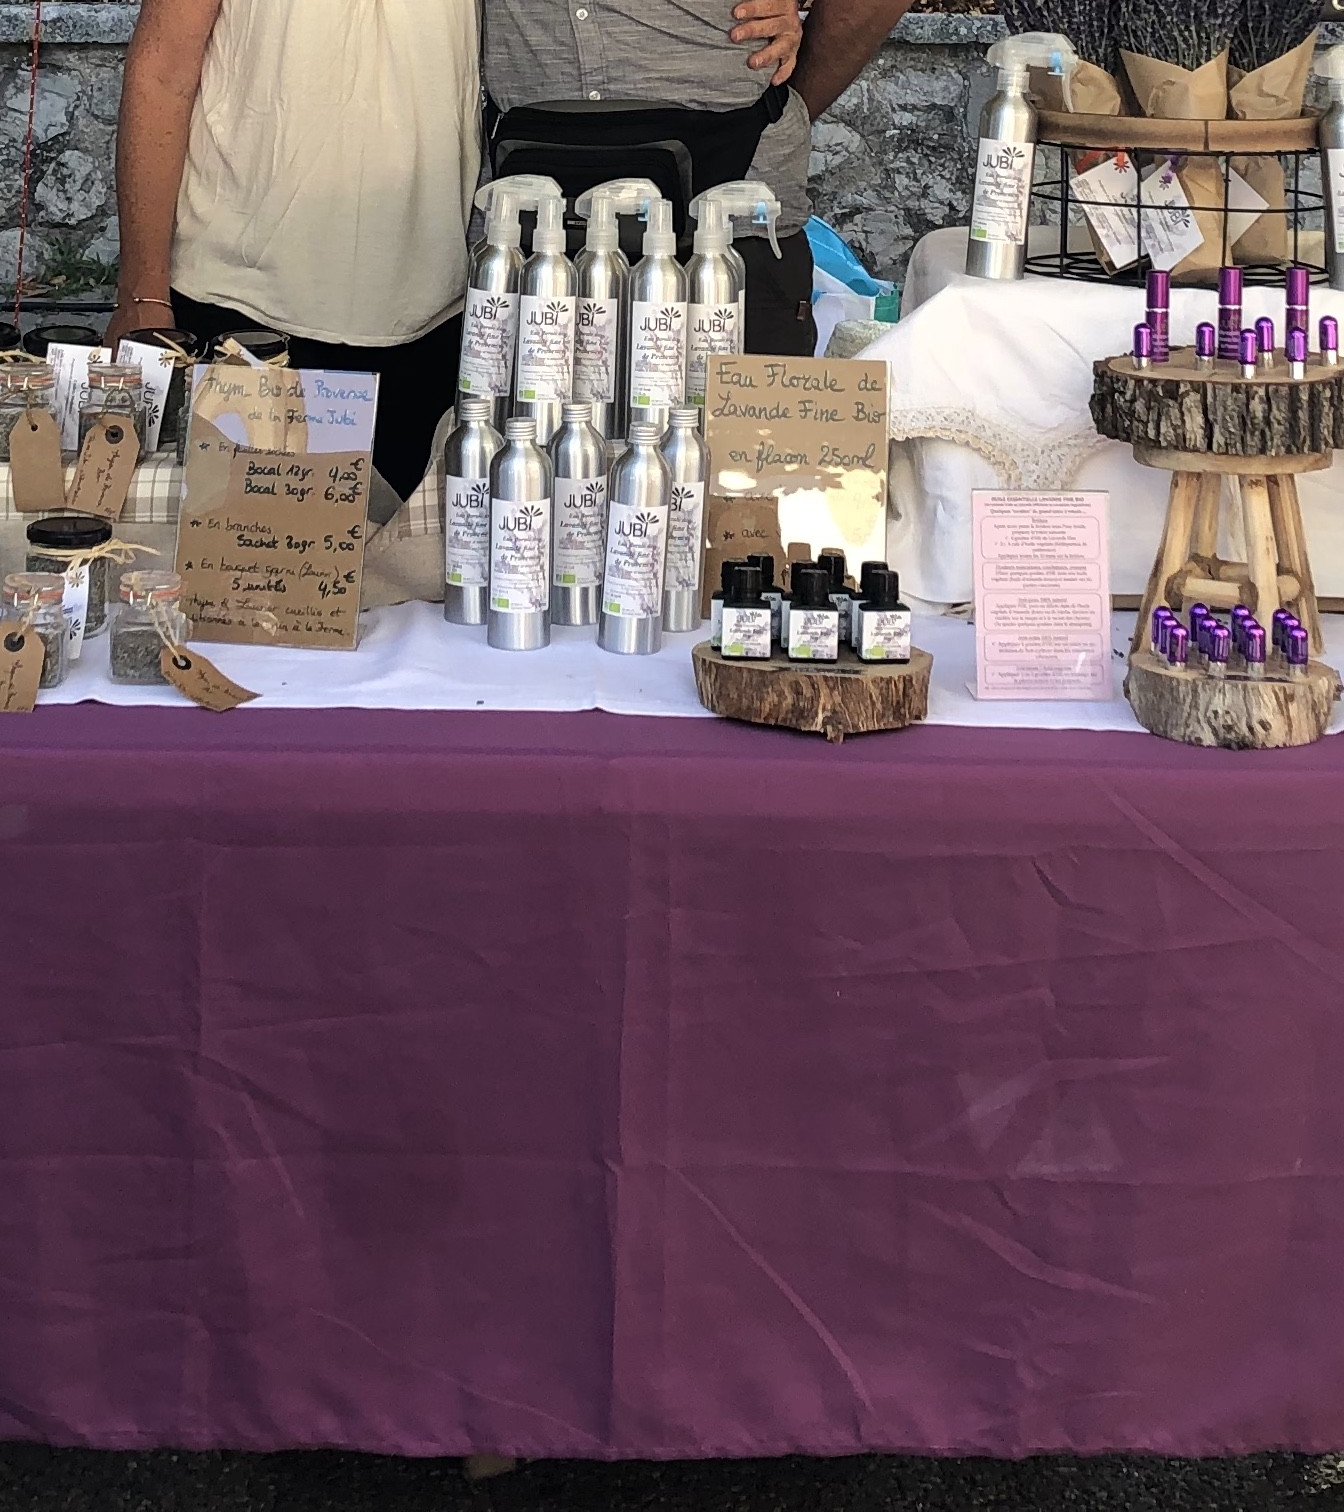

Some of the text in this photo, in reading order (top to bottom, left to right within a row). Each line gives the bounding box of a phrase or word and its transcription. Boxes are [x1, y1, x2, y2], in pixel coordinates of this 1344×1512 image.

[716, 361, 882, 392] Eau Florale de
[711, 390, 886, 424] Lavande Fine Bio
[327, 409, 358, 426] Jubi
[729, 440, 876, 473] en flacon 250ml
[245, 461, 282, 477] Bocal
[244, 478, 278, 496] Bocal
[208, 518, 220, 530] En
[741, 528, 770, 538] avec
[237, 534, 280, 550] Sachet
[201, 558, 214, 571] En
[232, 578, 241, 592] 5
